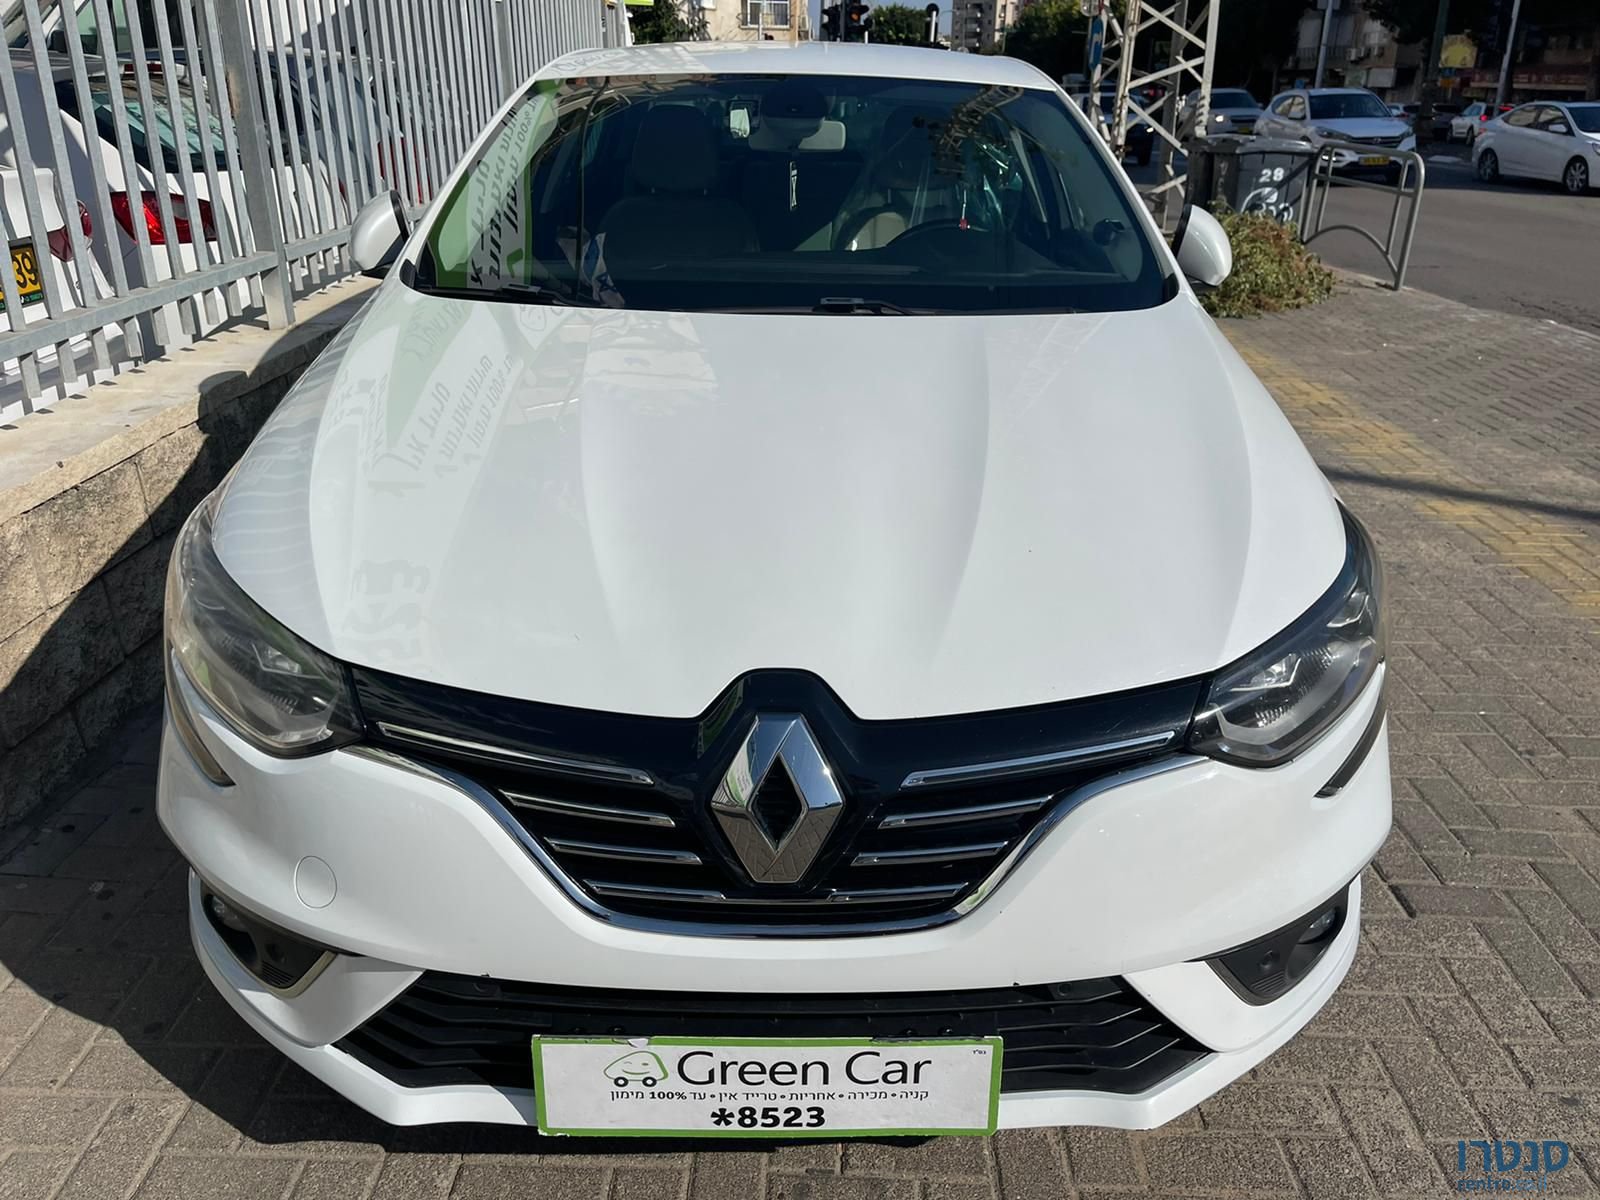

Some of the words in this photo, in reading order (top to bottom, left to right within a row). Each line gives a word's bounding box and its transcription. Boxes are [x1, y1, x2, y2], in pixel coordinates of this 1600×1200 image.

[1258, 167, 1285, 183] 28
[677, 1050, 829, 1086] Green
[845, 1050, 932, 1085] Car
[610, 1090, 645, 1101] מימון
[649, 1091, 687, 1100] 100%
[690, 1092, 707, 1101] עד
[718, 1092, 738, 1102] אין
[742, 1092, 777, 1100] טרייד
[788, 1091, 836, 1100] אחריות
[847, 1090, 888, 1100] מכירה
[899, 1090, 929, 1101] קניה
